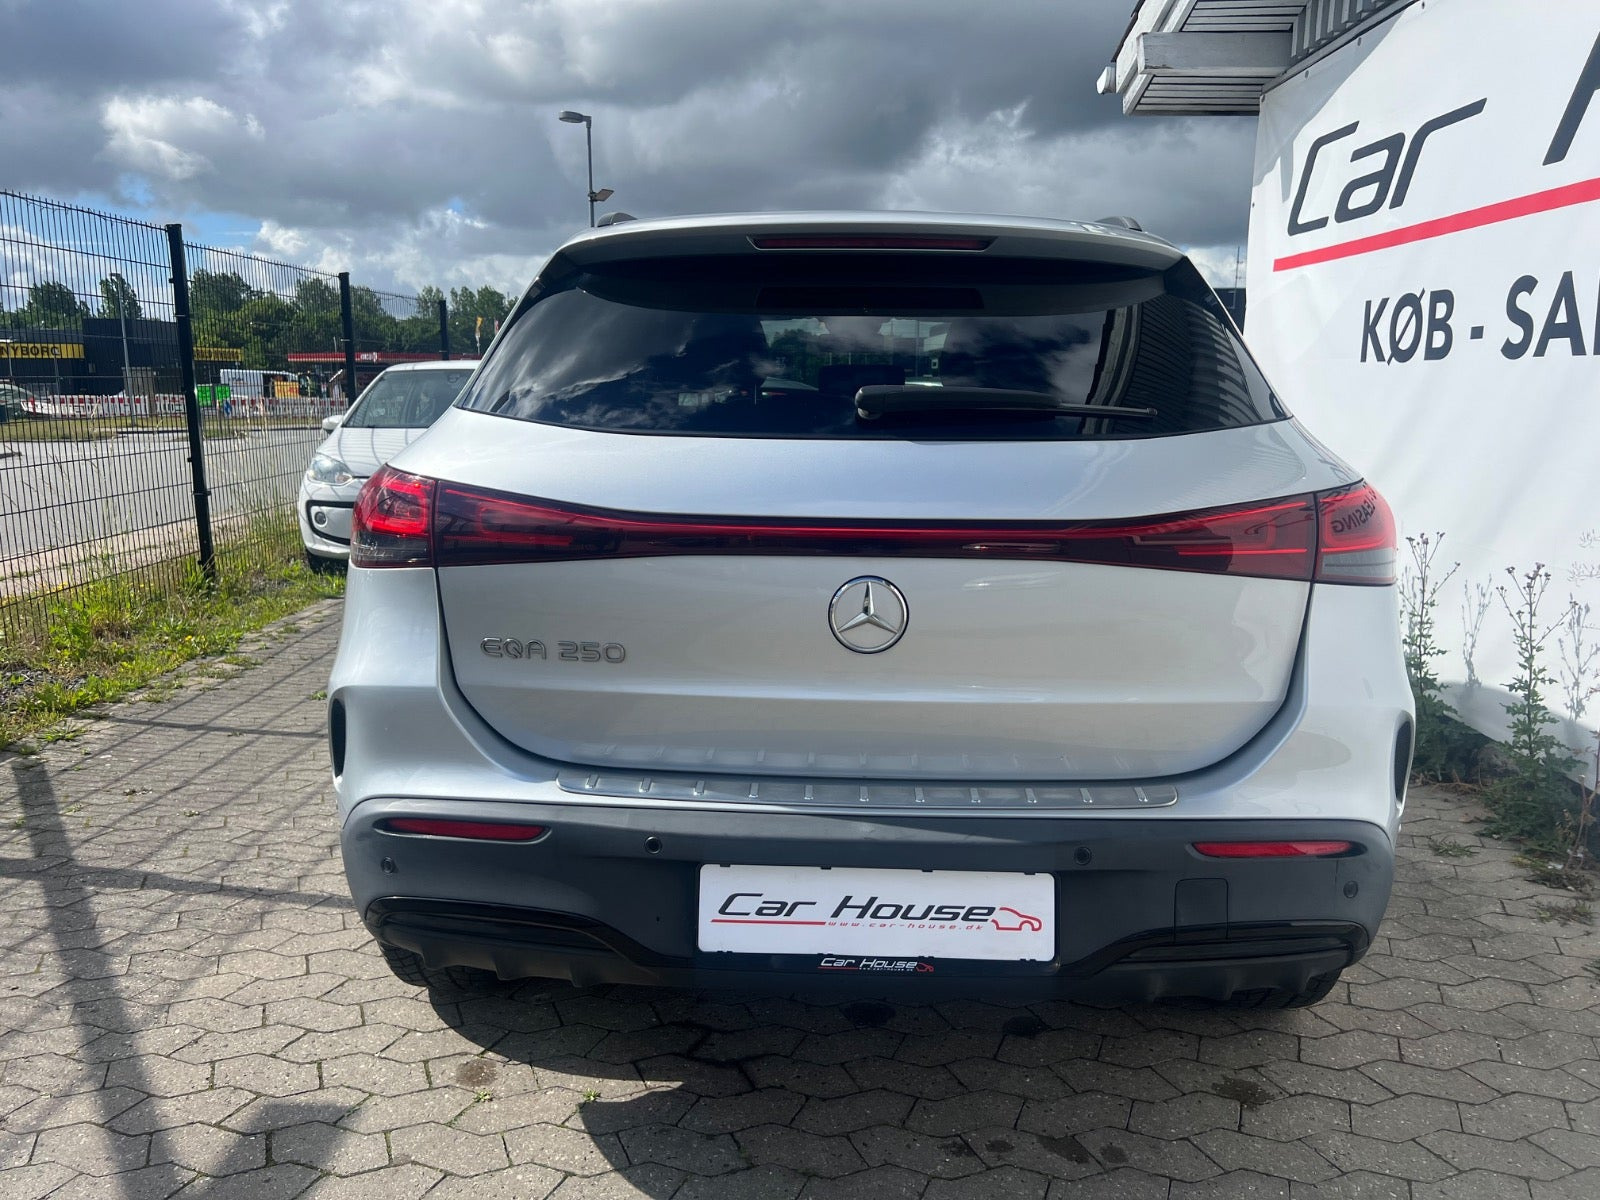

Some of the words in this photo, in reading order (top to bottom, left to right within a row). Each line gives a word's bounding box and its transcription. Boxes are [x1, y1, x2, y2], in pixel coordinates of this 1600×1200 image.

[1287, 97, 1488, 236] Car
[1360, 287, 1455, 366] KØB
[1500, 270, 1600, 360] SA
[480, 637, 547, 660] EQA
[557, 640, 626, 664] 250
[718, 893, 817, 917] Car
[830, 895, 996, 922] House
[828, 921, 983, 930] www.car-house.dk
[820, 957, 855, 967] Car
[859, 958, 918, 969] House
